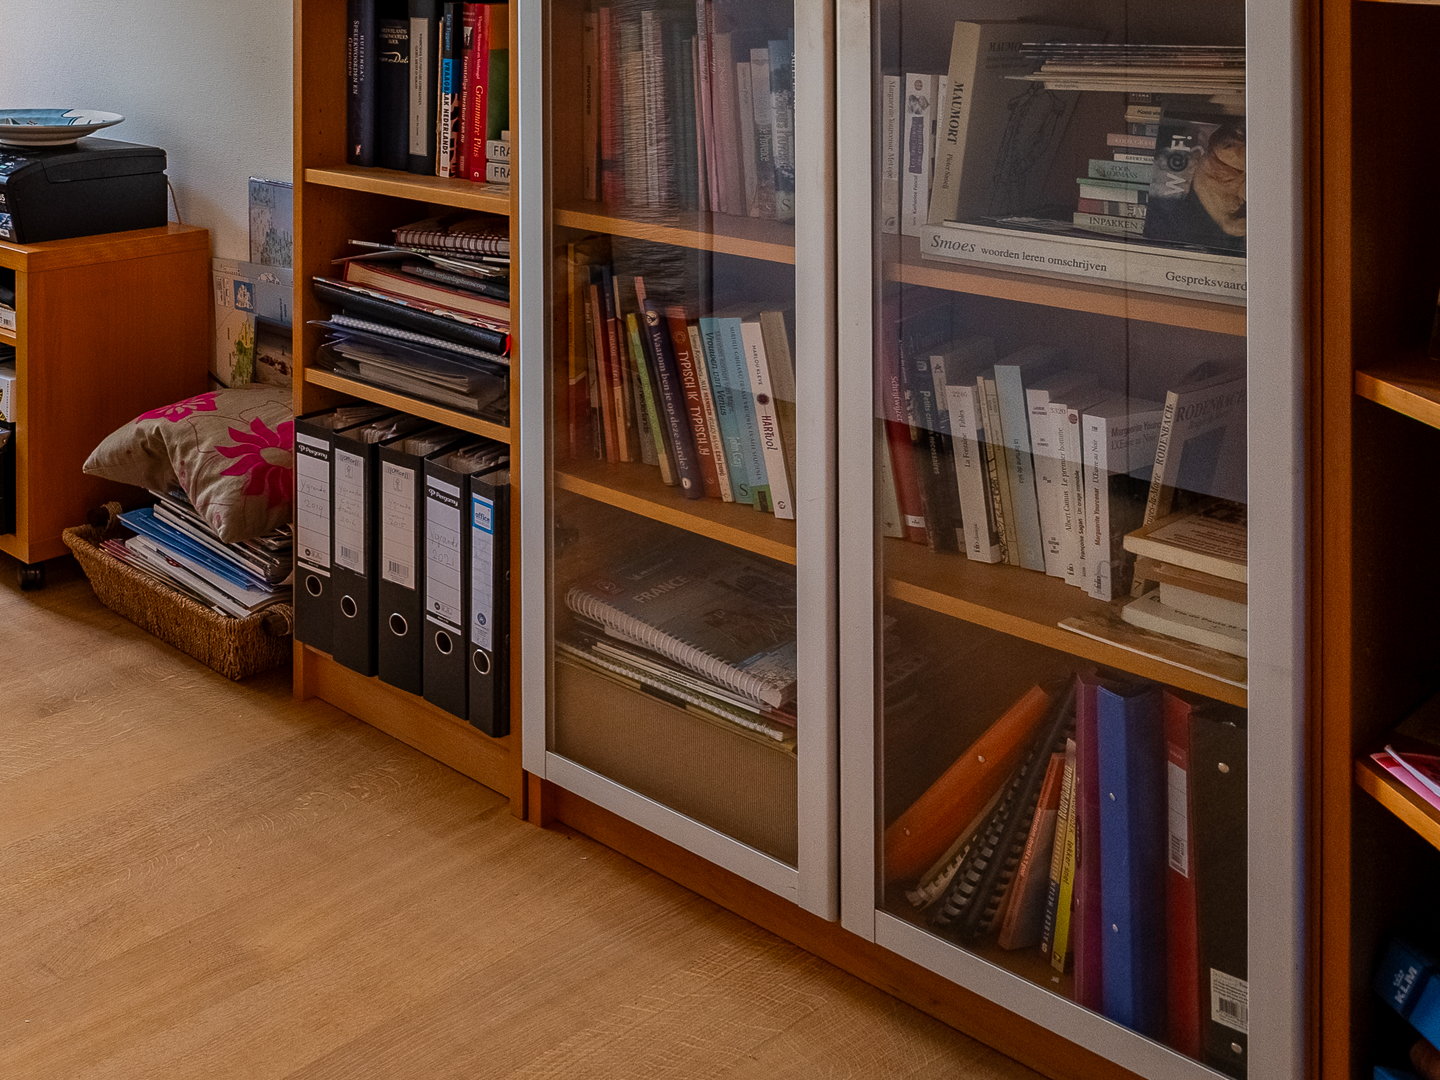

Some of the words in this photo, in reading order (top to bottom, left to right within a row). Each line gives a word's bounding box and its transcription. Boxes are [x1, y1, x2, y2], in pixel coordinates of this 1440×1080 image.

[352, 20, 360, 83] SPREEKWOORDEN
[352, 84, 359, 95] EN
[473, 85, 484, 136] Grammaire
[947, 80, 964, 145] MAUMORT
[442, 108, 450, 155] NEDERLANDS
[460, 134, 466, 143] nu
[473, 137, 482, 157] Plus
[1089, 216, 1138, 229] INPAKKEN
[931, 234, 977, 253] Smoes
[980, 245, 1020, 260] woorden
[1022, 251, 1045, 263] leren
[1047, 255, 1108, 273] omschrijven
[652, 332, 667, 372] Waarom
[706, 332, 718, 367] Vrouwen
[661, 373, 672, 390] ben
[678, 350, 697, 389] TYPISCH
[710, 368, 720, 384] van
[664, 392, 673, 401] je
[666, 402, 676, 415] op
[688, 391, 699, 402] IK
[715, 386, 728, 416] Venus
[890, 375, 904, 422] Schrijfwijzer
[919, 390, 932, 411] Petits
[670, 416, 680, 438] deze
[690, 406, 706, 444] TYPISCH
[925, 412, 933, 435] crimes
[1155, 402, 1175, 466] RODENBACH
[727, 436, 743, 451] John
[1058, 427, 1066, 454] homme
[306, 448, 328, 459] Pergamy
[675, 439, 688, 471] aarde?
[731, 452, 744, 468] Gray
[928, 435, 941, 475] nécessaires
[1060, 455, 1069, 478] premier
[1061, 478, 1068, 487] Le
[435, 491, 459, 507] Pergamy
[1062, 490, 1071, 514] Camus
[474, 511, 491, 523] office
[1063, 515, 1072, 532] Albert
[632, 575, 692, 604] FRANCE
[1057, 766, 1073, 819] Roerbakken
[1065, 839, 1075, 867] lekker
[1043, 909, 1053, 942] ALBERT
[1048, 881, 1057, 907] HEIJN
[1394, 965, 1418, 1005] KLM
